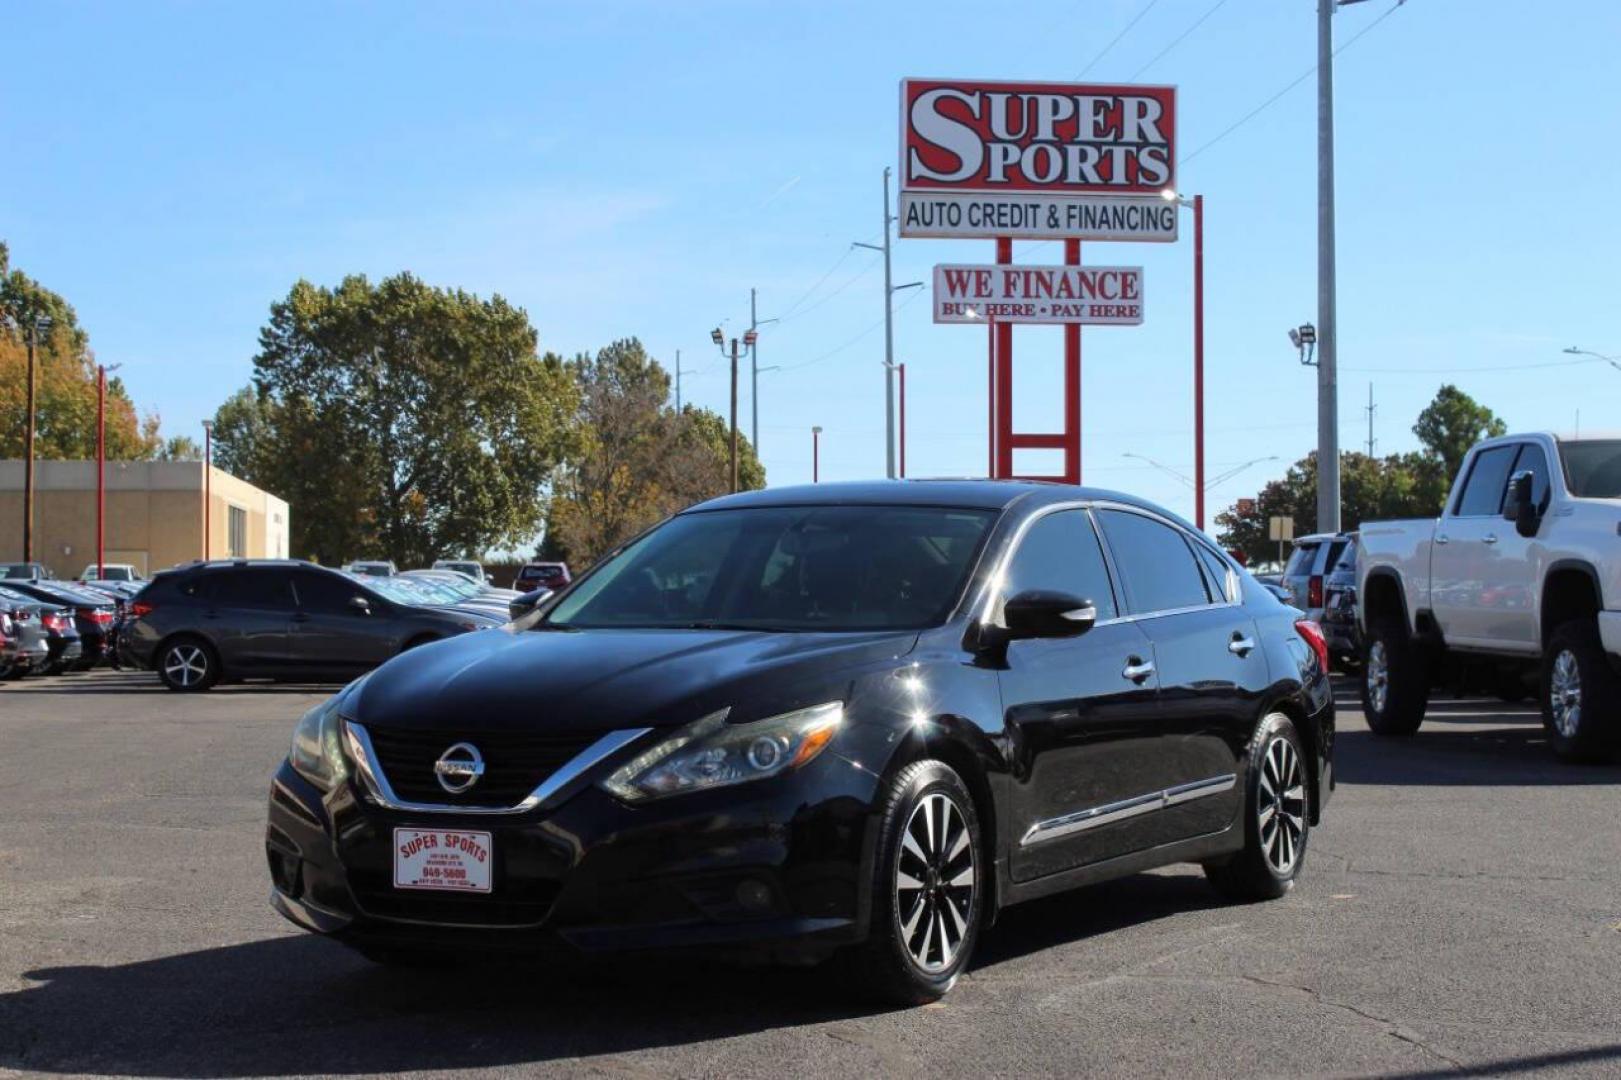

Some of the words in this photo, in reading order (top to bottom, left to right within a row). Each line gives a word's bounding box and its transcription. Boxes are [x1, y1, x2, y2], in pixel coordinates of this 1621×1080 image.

[911, 87, 1167, 183] SUPER
[906, 202, 962, 228] AUTO
[967, 203, 1041, 229] CREDIT
[1045, 204, 1060, 229] &
[1066, 205, 1174, 232] FINANCING
[944, 269, 993, 298] WE
[1002, 270, 1138, 300] FINANCE
[985, 303, 1036, 317] HERE
[1051, 304, 1084, 317] PAY
[1089, 304, 1140, 318] HERE
[400, 834, 438, 858] SUPER
[445, 834, 487, 863] SPORTS
